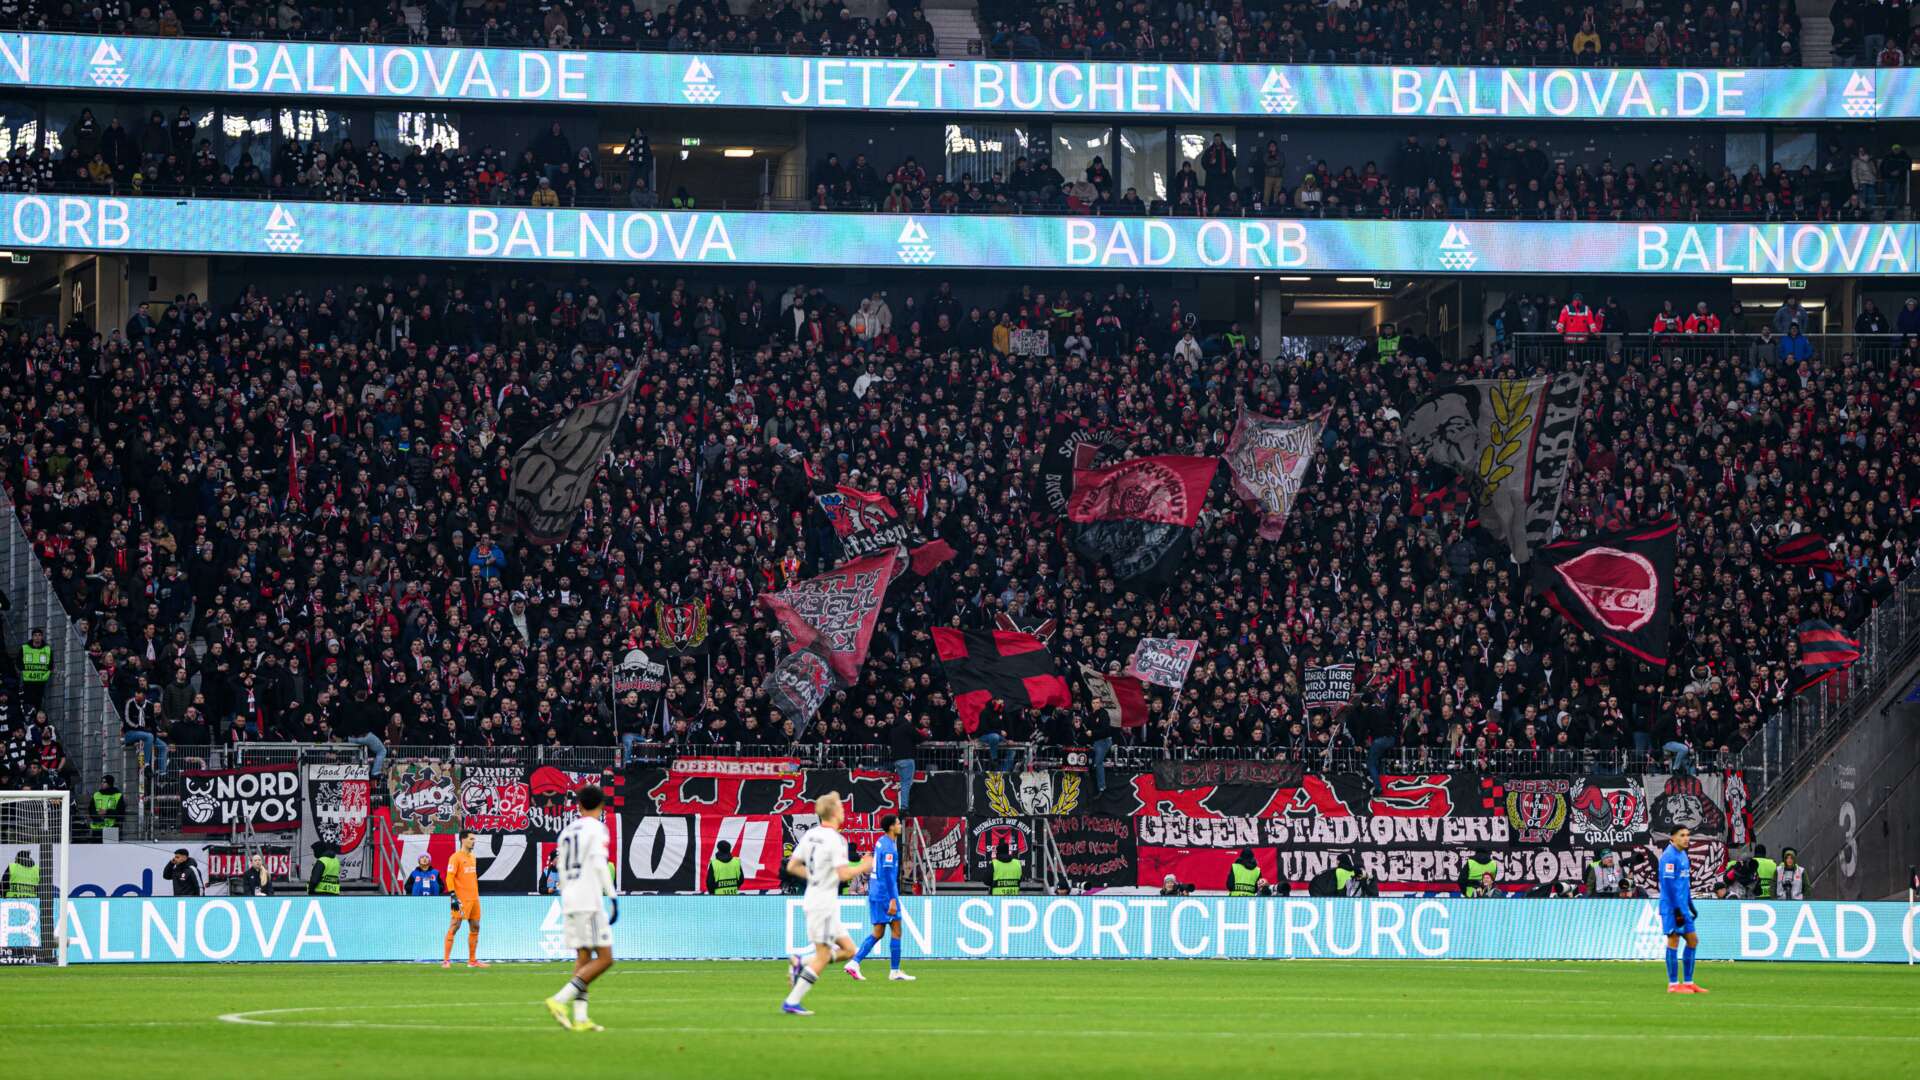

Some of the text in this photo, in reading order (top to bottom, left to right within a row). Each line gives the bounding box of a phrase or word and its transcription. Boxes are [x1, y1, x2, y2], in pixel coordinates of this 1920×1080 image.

[227, 44, 588, 99] BALNOVA.DE
[782, 60, 1201, 110] JETZT BUCHEN
[1393, 70, 1745, 117] BALNOVA.DE
[13, 199, 131, 246] ORB
[468, 209, 735, 261] BALNOVA
[1066, 219, 1308, 268] BAD ORB
[1638, 225, 1908, 272] BALNOVA
[1329, 670, 1352, 680] LIEBE
[217, 772, 299, 799] NORD
[465, 767, 525, 777] FARBEN
[471, 777, 520, 787] STADT
[1504, 779, 1570, 793] JUGEND
[394, 784, 456, 810] CHAOS
[1140, 816, 1260, 847] GEGEN
[956, 898, 1450, 957] SPORTCHIRURG
[1740, 902, 1877, 958] BAD
